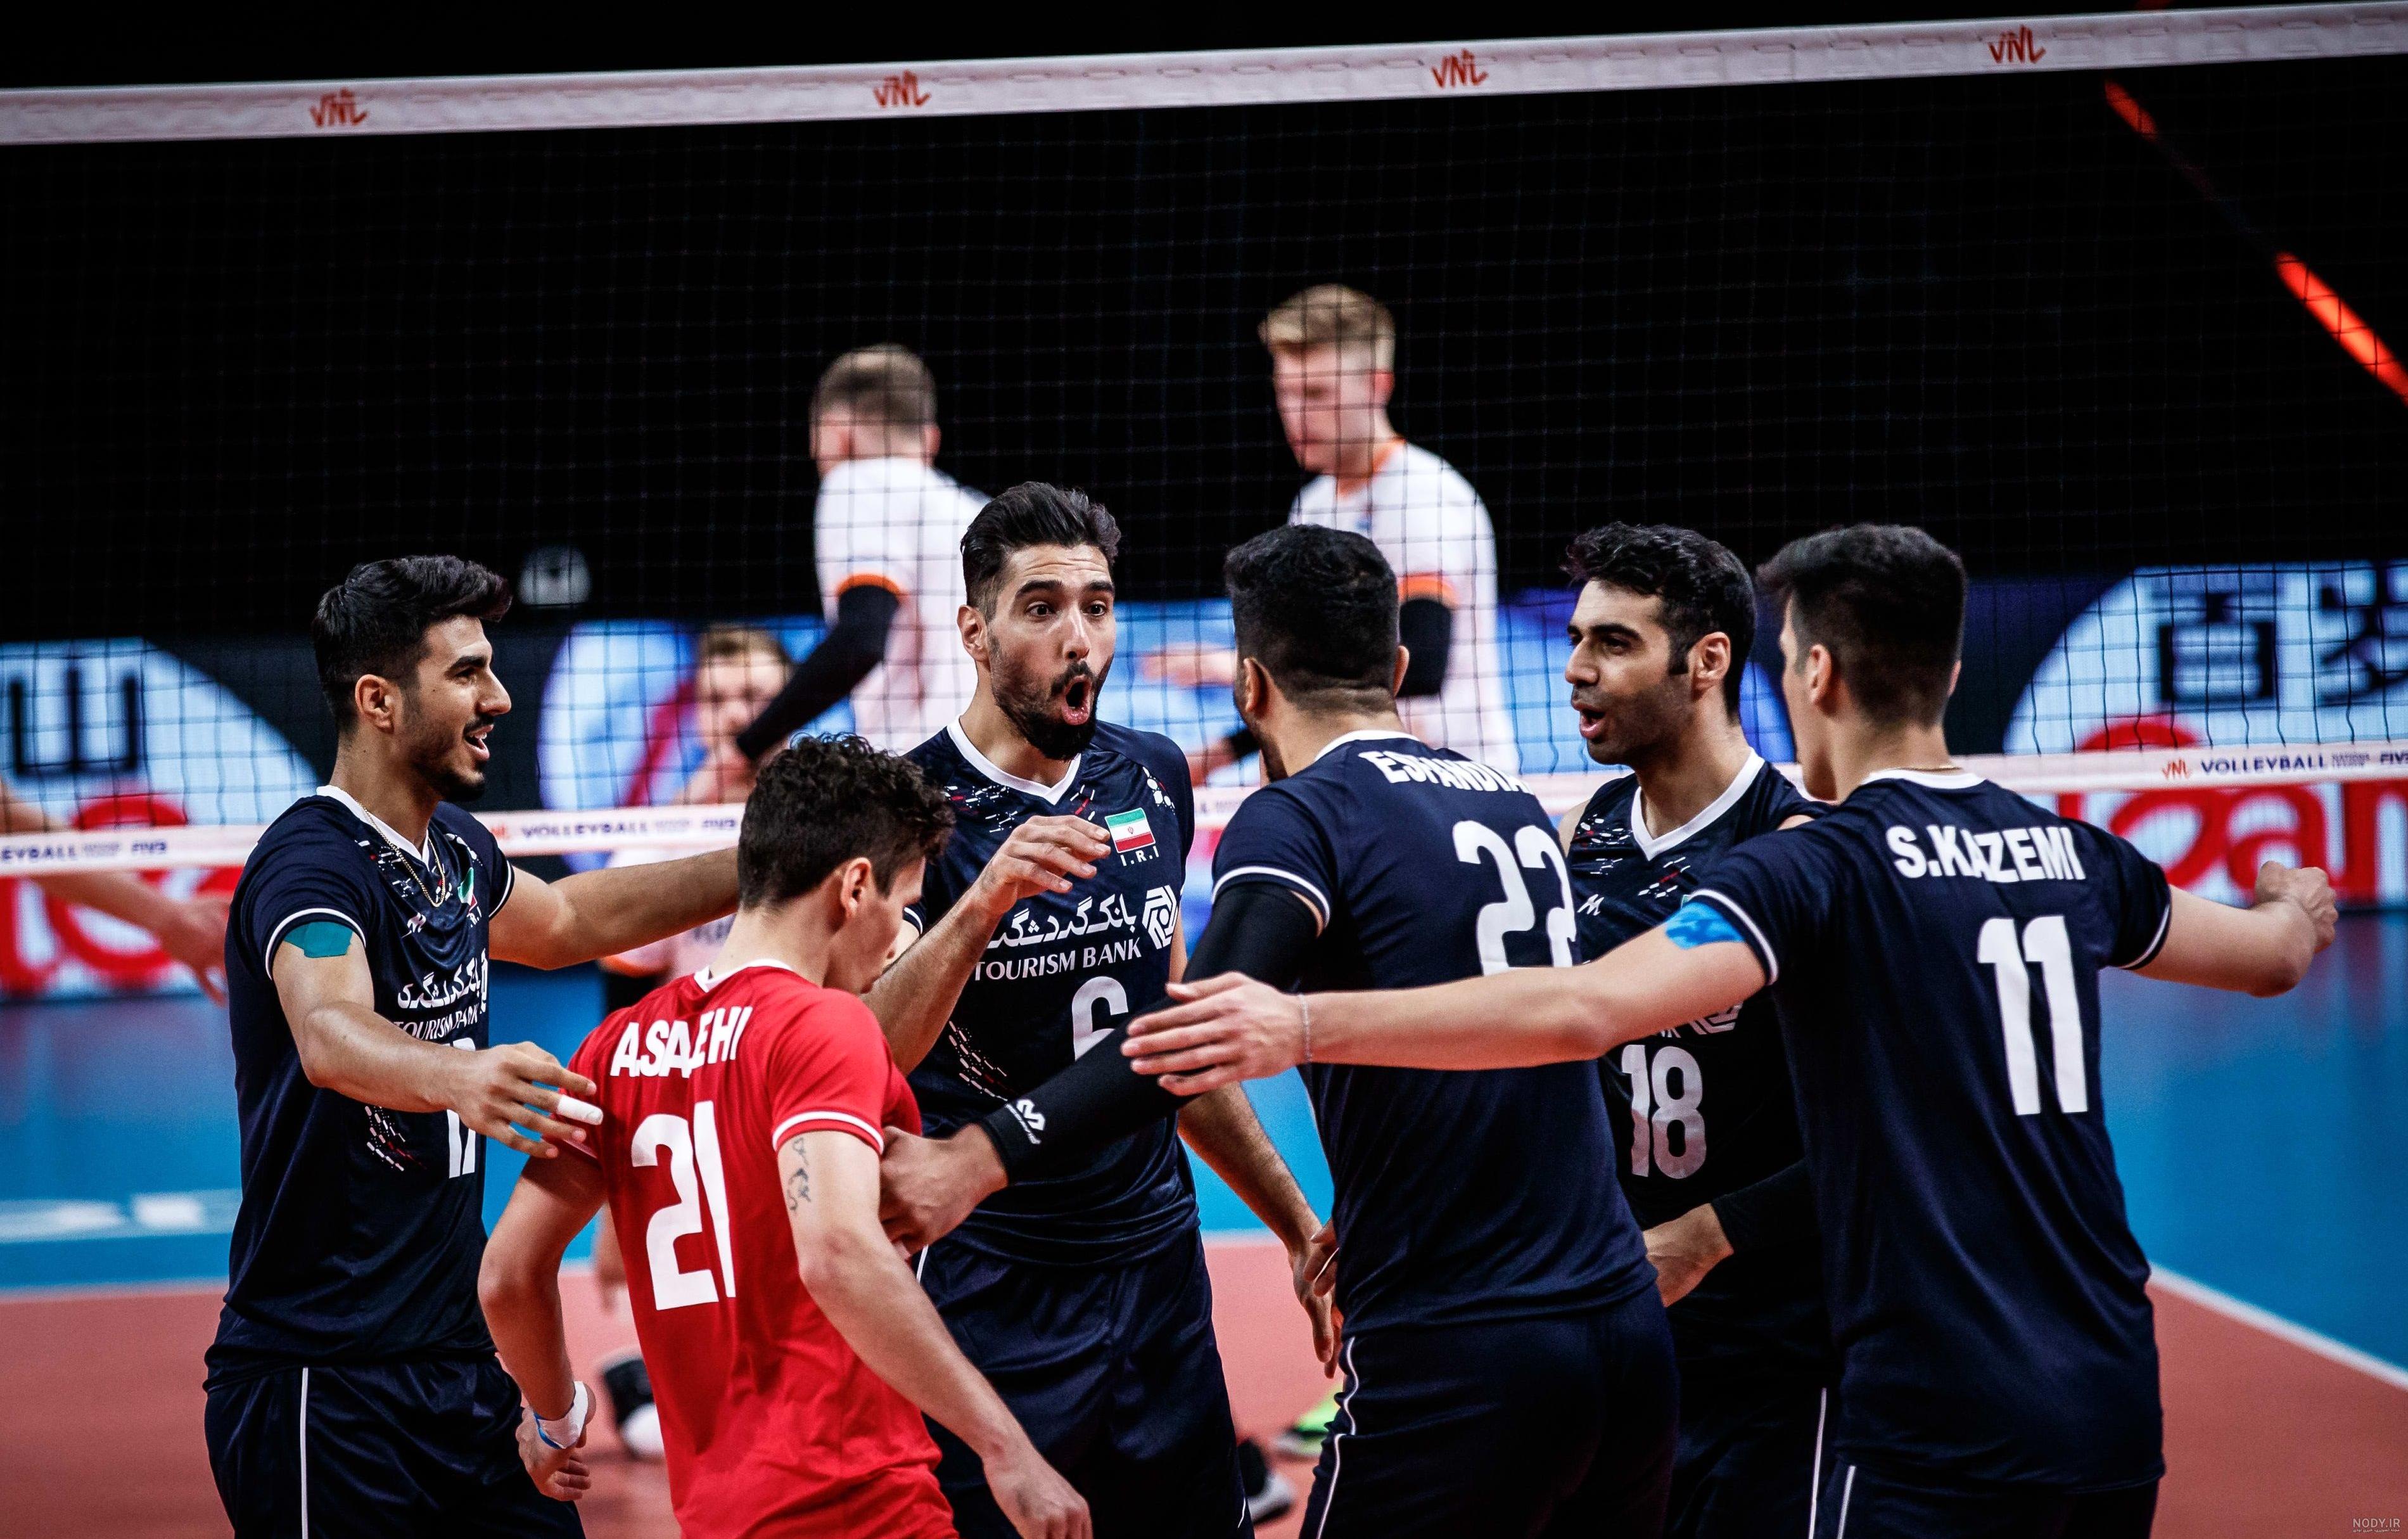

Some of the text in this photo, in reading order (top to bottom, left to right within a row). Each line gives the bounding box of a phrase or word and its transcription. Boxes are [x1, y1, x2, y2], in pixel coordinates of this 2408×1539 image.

[1358, 750, 1536, 796] ESFANDIA
[2201, 754, 2324, 775] VOLLEYBALL
[1886, 825, 2086, 883] S.KAZEMI
[986, 893, 1137, 949] بانک گردشگر
[975, 937, 1142, 981] TOURISM BANK
[1977, 915, 2088, 1116] 11
[1621, 1044, 1707, 1180] 18
[631, 1100, 737, 1311] 21
